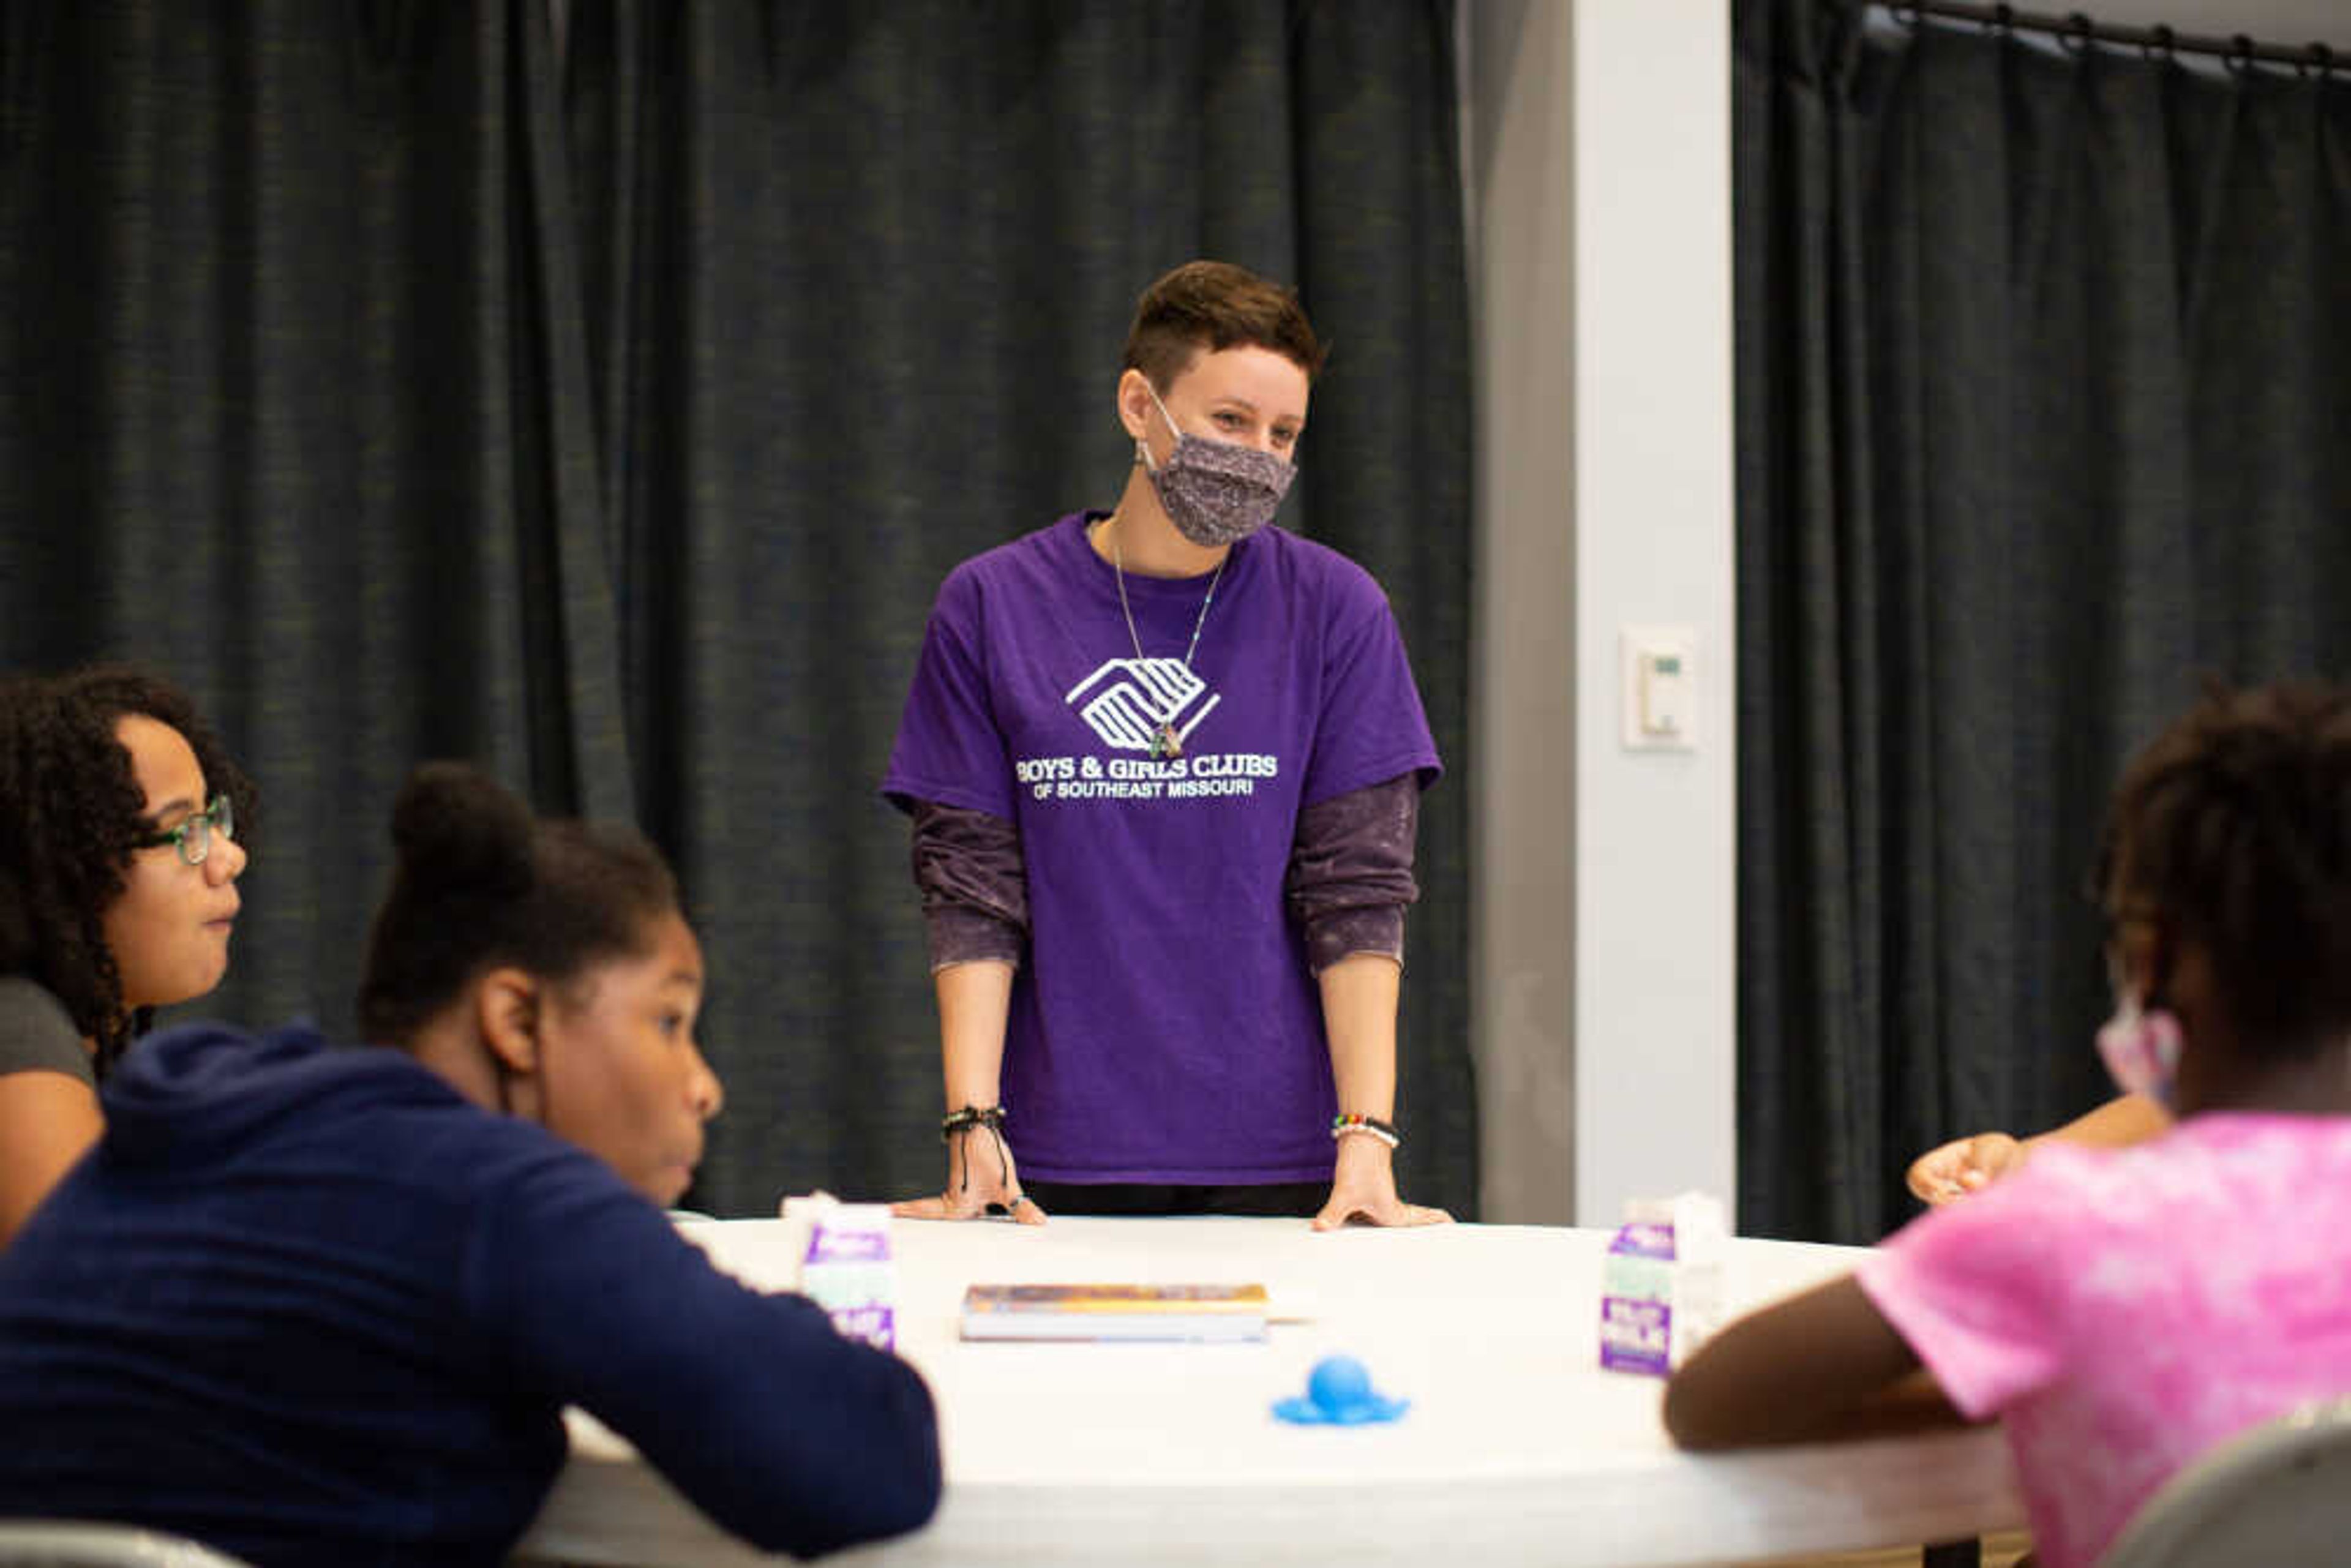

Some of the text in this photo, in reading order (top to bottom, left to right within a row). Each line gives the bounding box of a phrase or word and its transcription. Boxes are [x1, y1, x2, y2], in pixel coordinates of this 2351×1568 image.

[1081, 756, 1102, 779] &
[1109, 759, 1187, 779] GIRLS
[1191, 754, 1278, 777] CLUBS
[1034, 778, 1253, 799] OF SOUTHEAST MISSOURI
